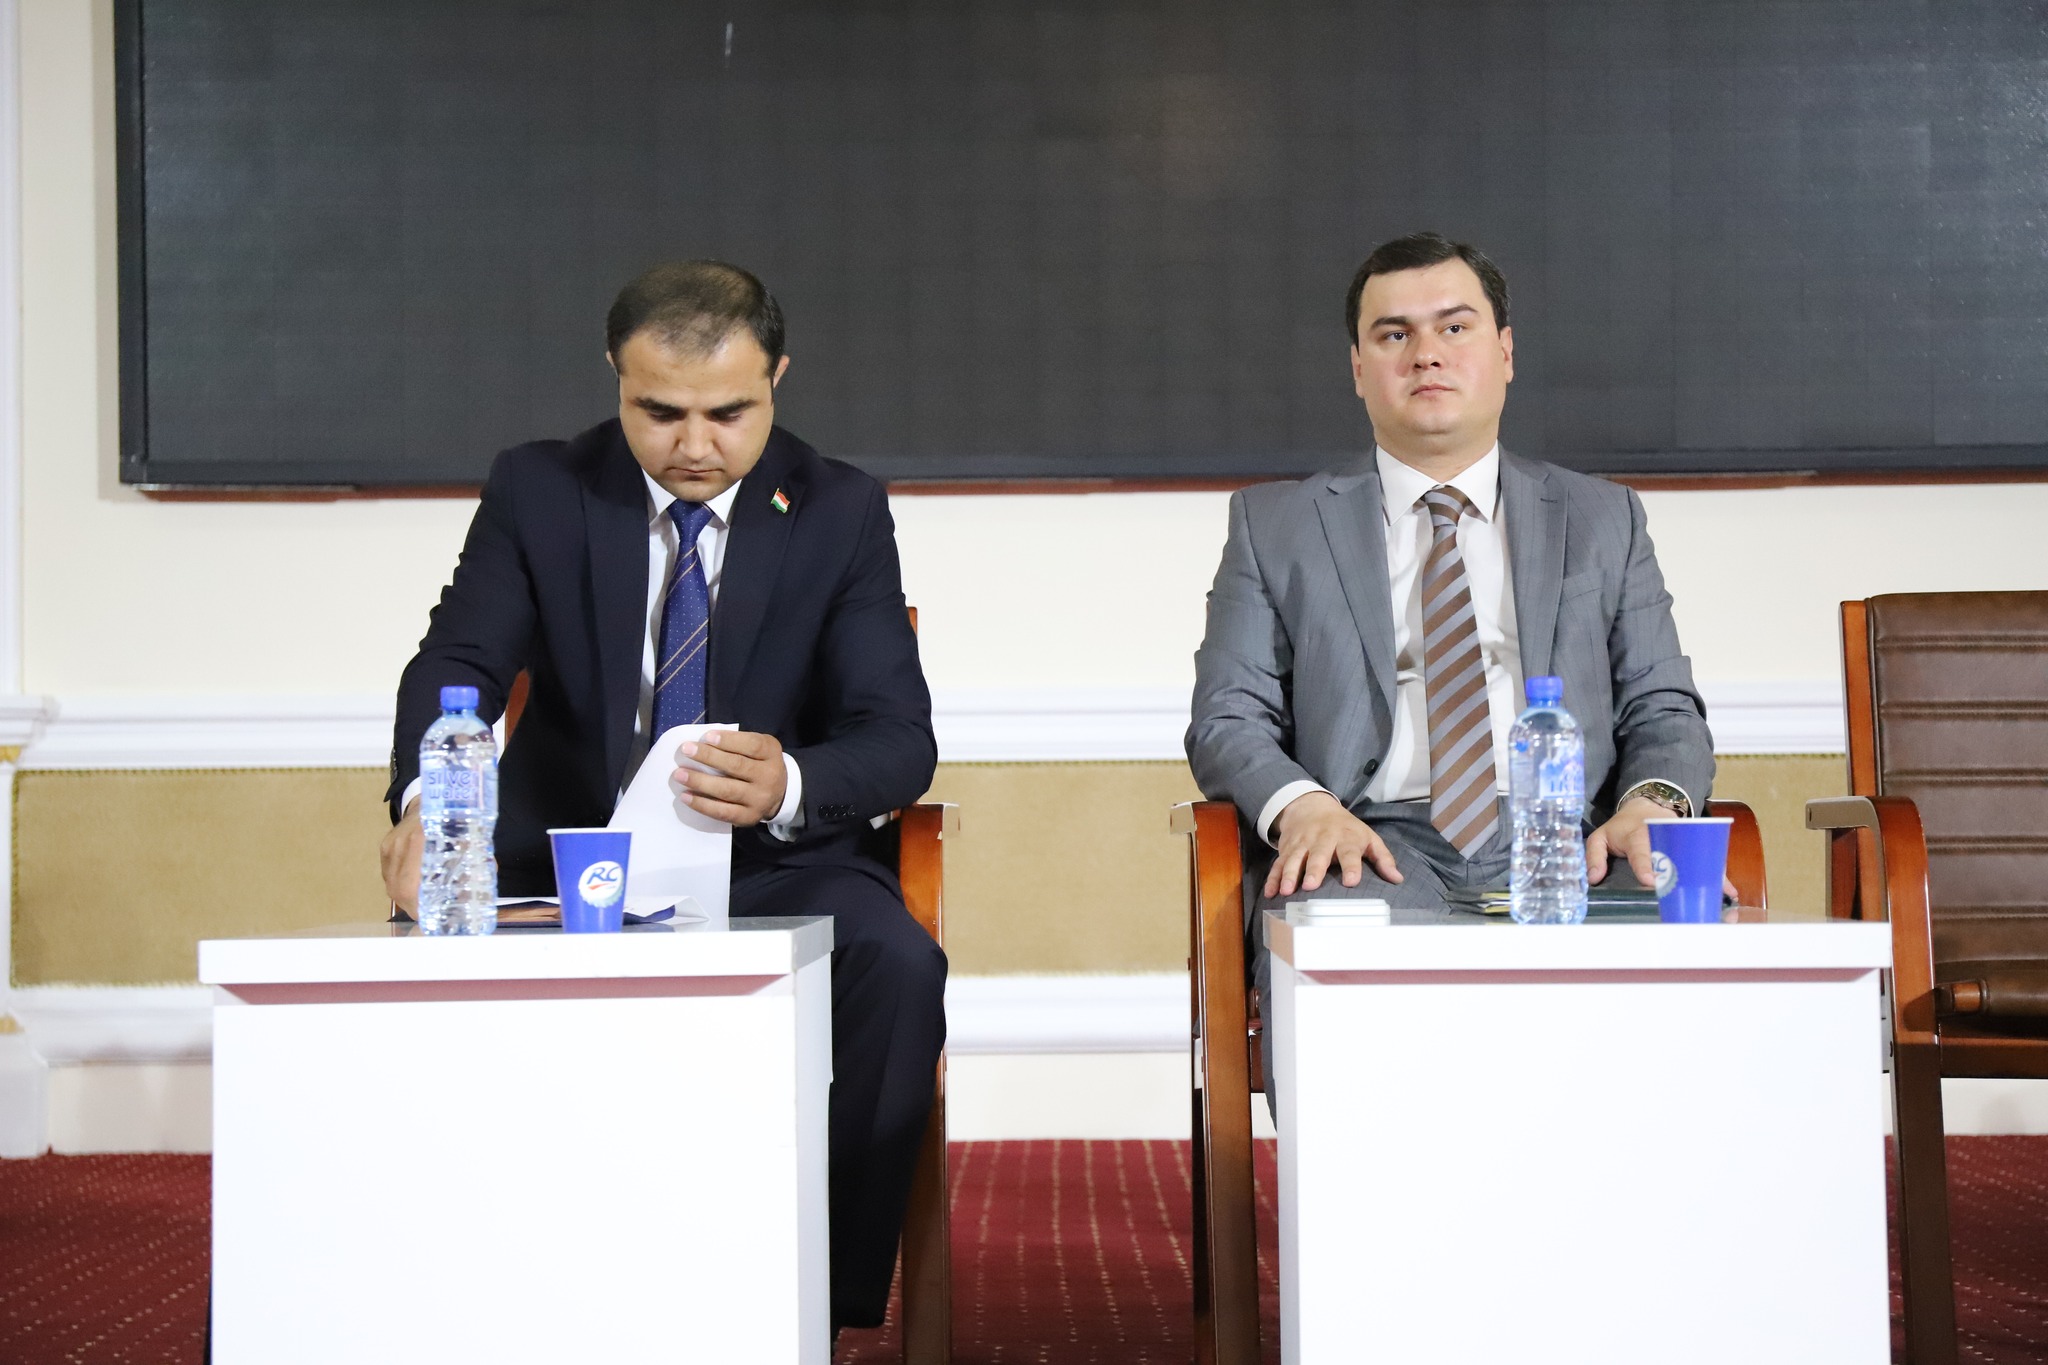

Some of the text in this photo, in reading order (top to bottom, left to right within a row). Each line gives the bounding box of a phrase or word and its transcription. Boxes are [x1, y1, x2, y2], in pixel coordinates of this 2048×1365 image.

[428, 768, 479, 785] silver
[428, 787, 478, 800] water
[587, 866, 620, 885] RC
